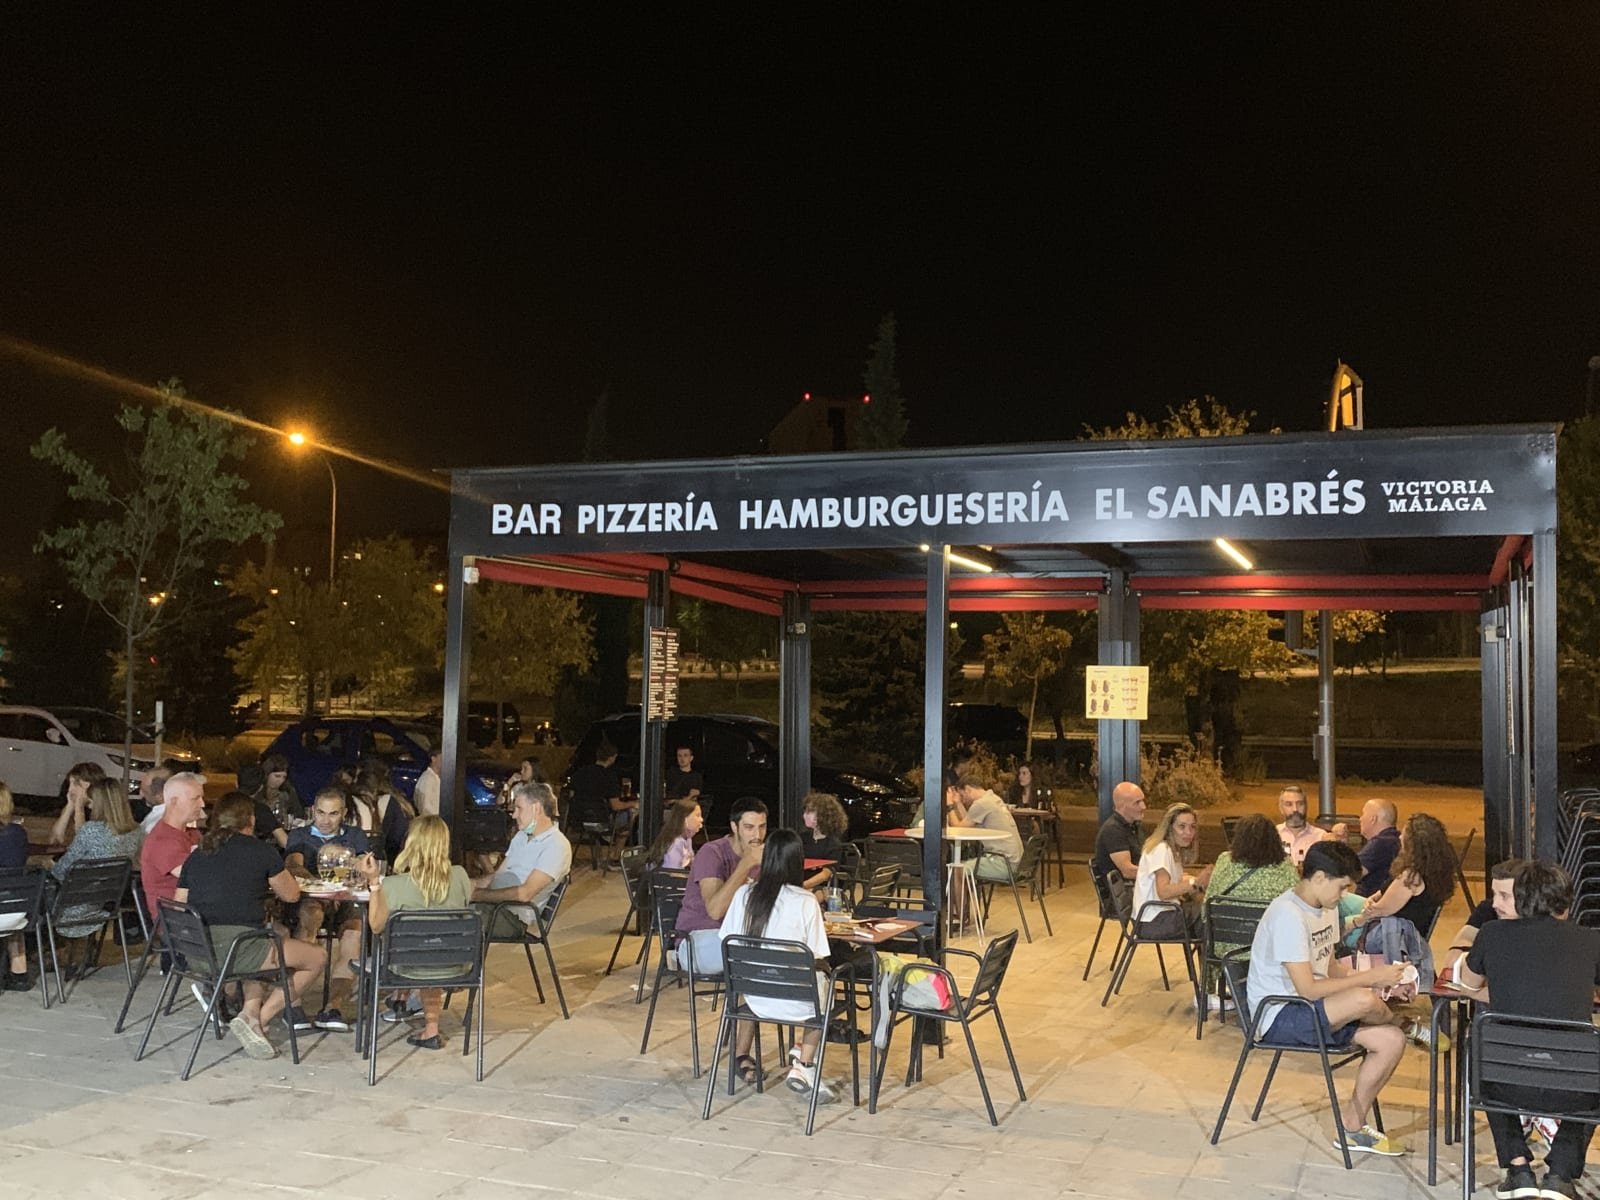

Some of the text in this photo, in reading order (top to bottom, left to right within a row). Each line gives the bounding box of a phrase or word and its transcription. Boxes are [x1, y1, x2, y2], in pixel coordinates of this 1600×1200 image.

[1381, 479, 1495, 496] VICTORIA
[493, 469, 1366, 534] BAR PIZZERÍA HAMBURGUESERÍA EL SANABRÉS
[1388, 495, 1488, 513] MÁLAGA
